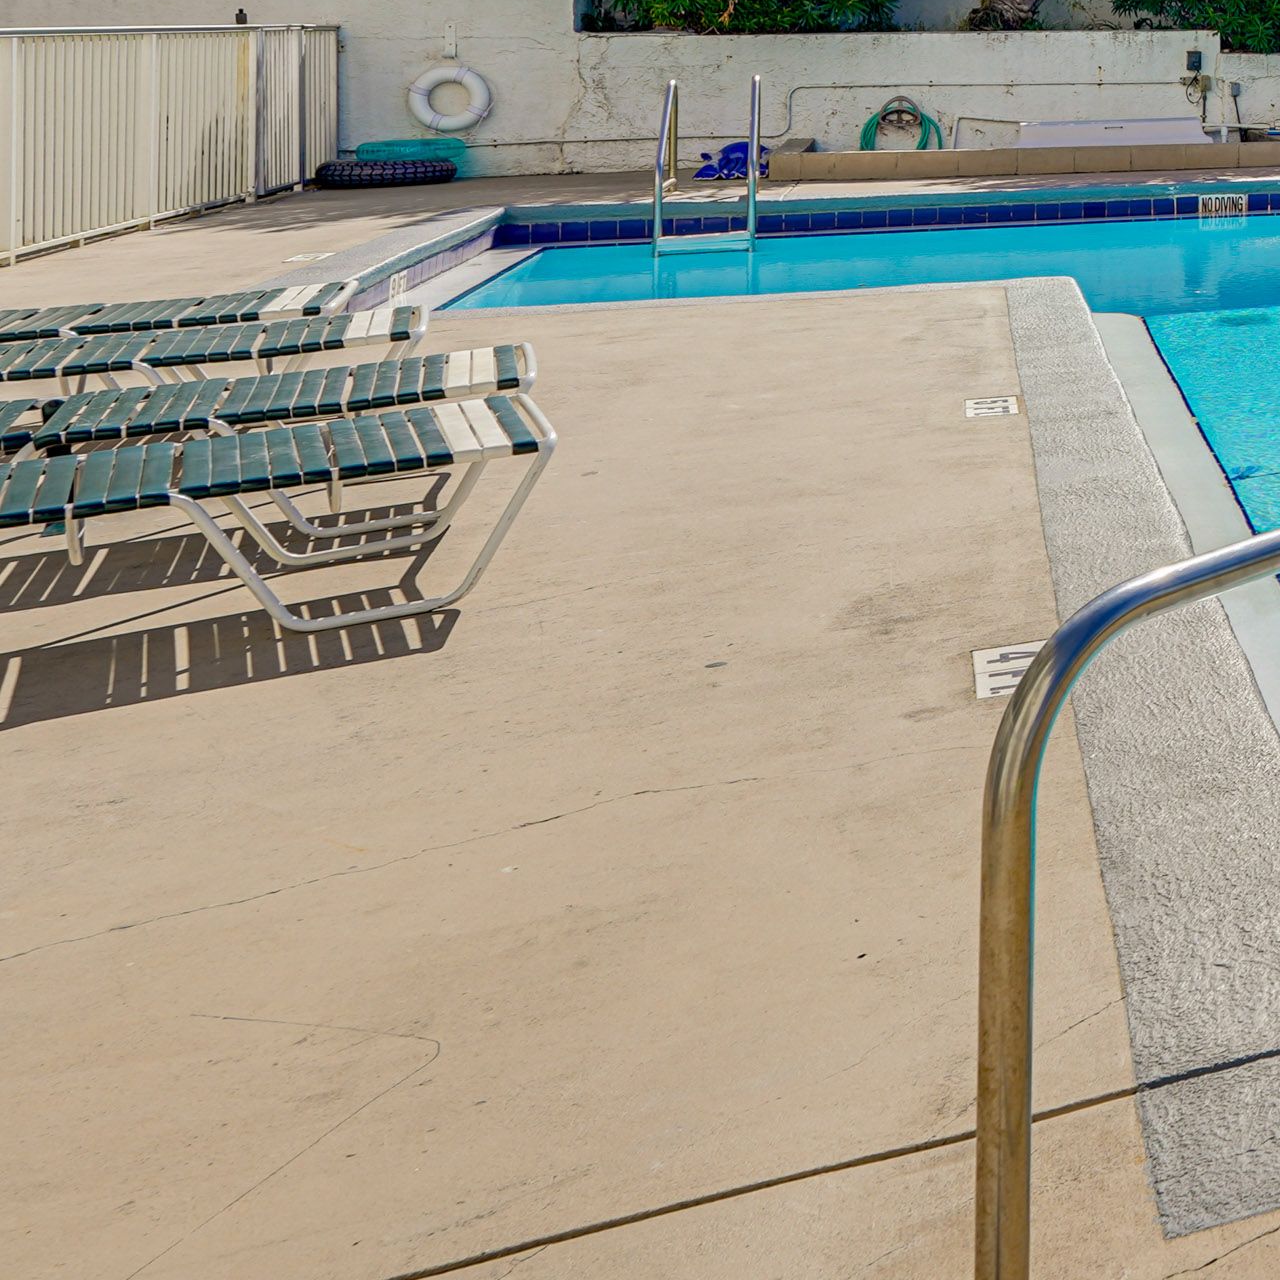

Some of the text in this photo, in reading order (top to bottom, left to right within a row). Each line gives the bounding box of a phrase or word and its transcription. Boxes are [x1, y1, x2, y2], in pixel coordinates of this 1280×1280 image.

[1202, 196, 1243, 212] NO DIVING
[986, 651, 1038, 664] 4
